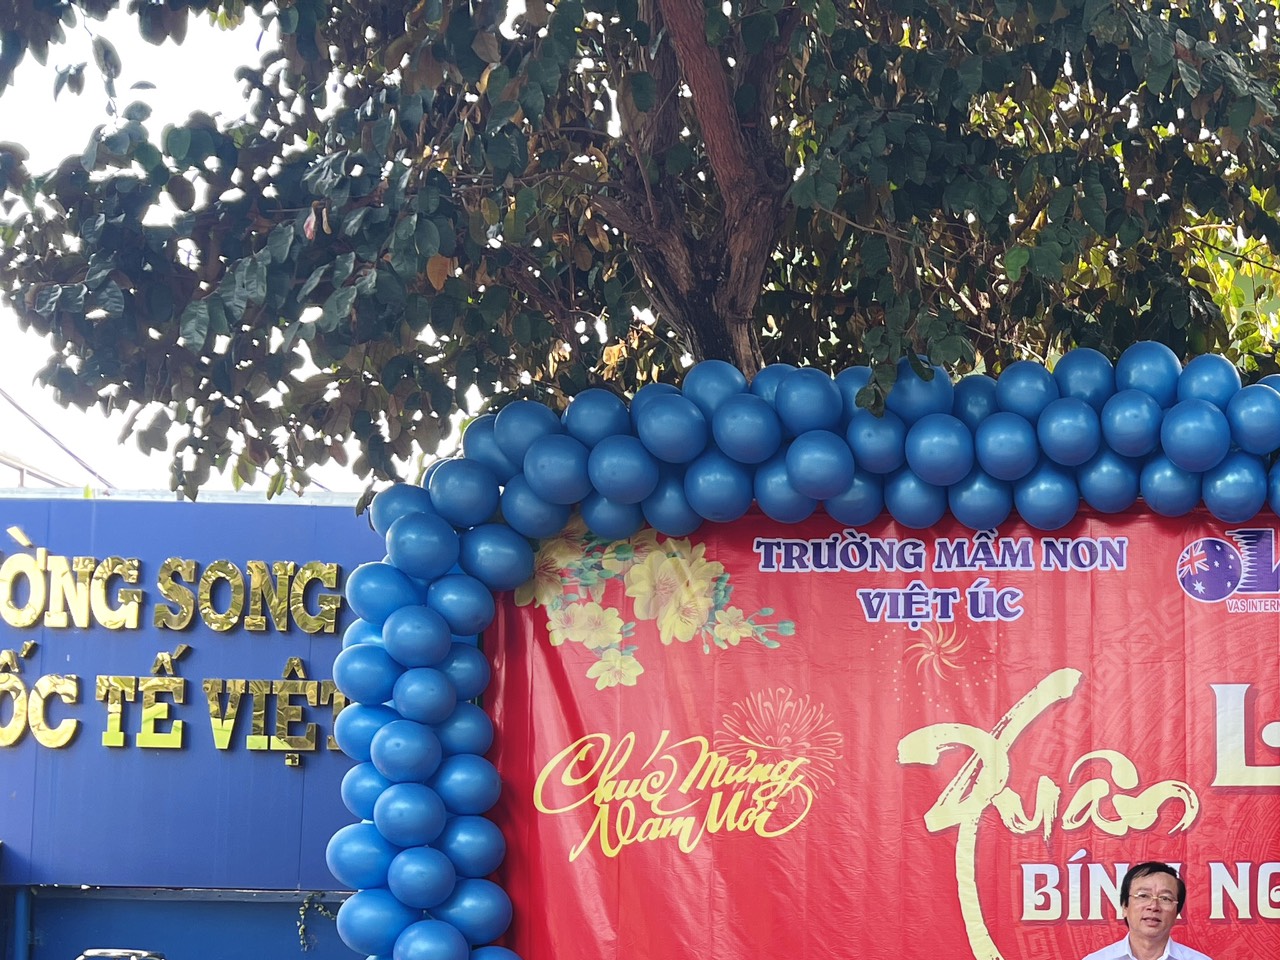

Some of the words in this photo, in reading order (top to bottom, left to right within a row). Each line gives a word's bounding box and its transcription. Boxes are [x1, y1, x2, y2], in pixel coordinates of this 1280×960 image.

[754, 530, 927, 571] TRƯỜNG
[934, 528, 1034, 570] MẦM
[1042, 537, 1128, 570] NON
[154, 556, 342, 633] SONG
[858, 581, 959, 629] VIỆT
[967, 579, 1024, 621] ÚC
[1226, 599, 1248, 613] VAS
[96, 643, 191, 749] TẾ
[1021, 849, 1182, 920] BÍN
